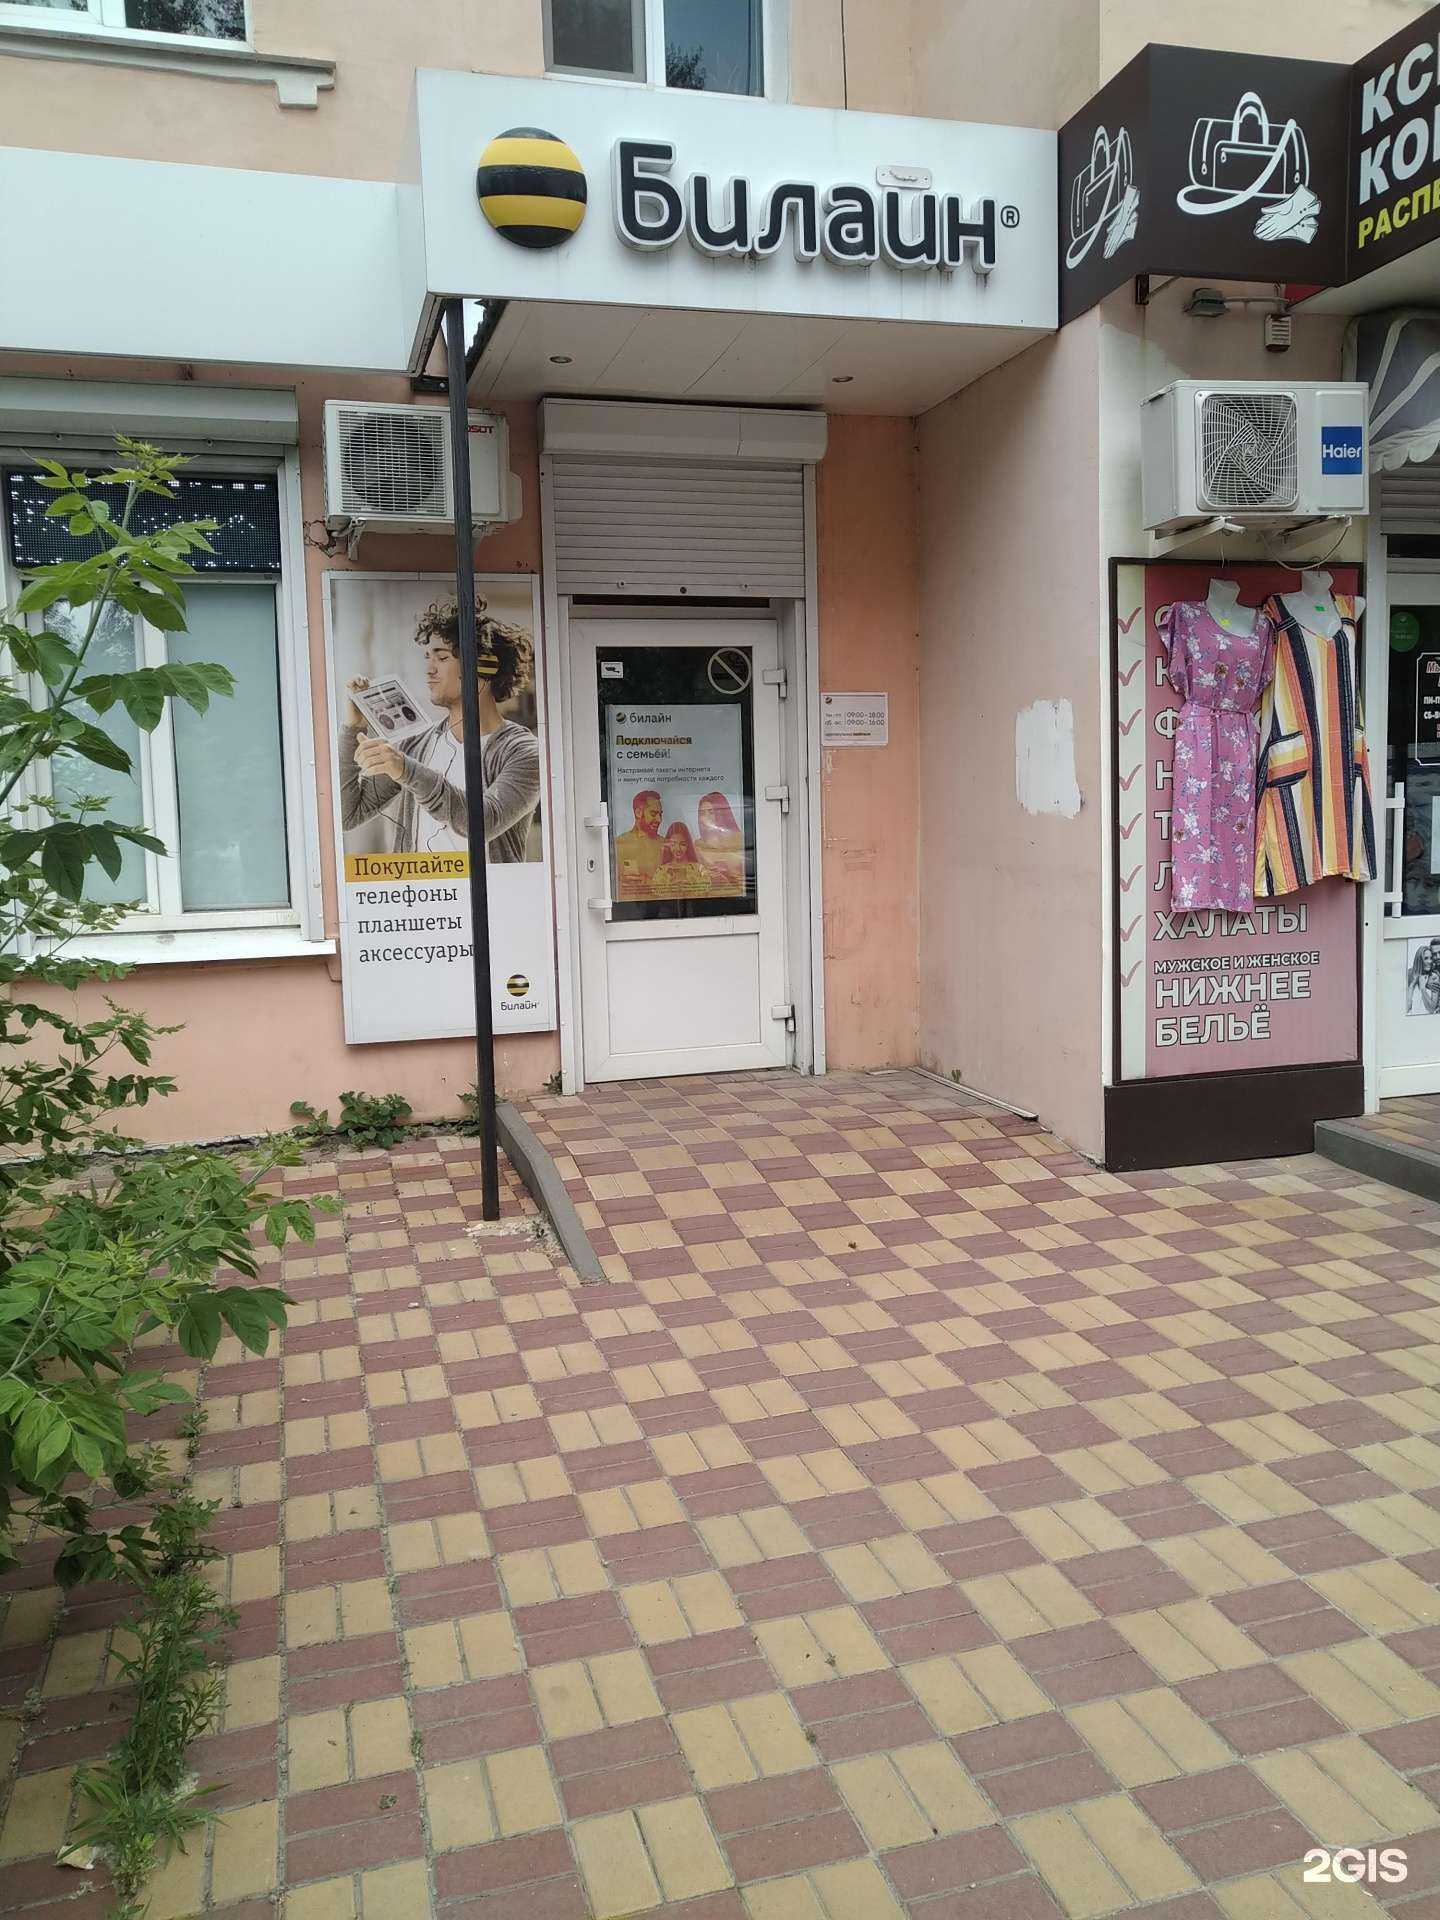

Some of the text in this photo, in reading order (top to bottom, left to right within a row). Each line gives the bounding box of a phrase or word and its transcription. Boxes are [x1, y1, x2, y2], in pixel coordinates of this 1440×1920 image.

[1361, 32, 1440, 134] КС
[1322, 443, 1362, 458] Haier
[629, 712, 672, 723] билайн
[616, 735, 692, 747] Подключайся
[616, 751, 624, 759] с
[354, 856, 465, 879] Покупайте
[356, 885, 459, 908] телефоны
[358, 916, 463, 934] планшеты
[1153, 904, 1308, 941] ХАЛАТЫ
[359, 944, 476, 964] аксессуары
[1153, 951, 1320, 975] МУЖСКОЕ И ЖЕНСКОЕ
[1155, 970, 1312, 1009] НИЖНЕЕ
[1155, 1003, 1271, 1047] БЕЛЬЁ
